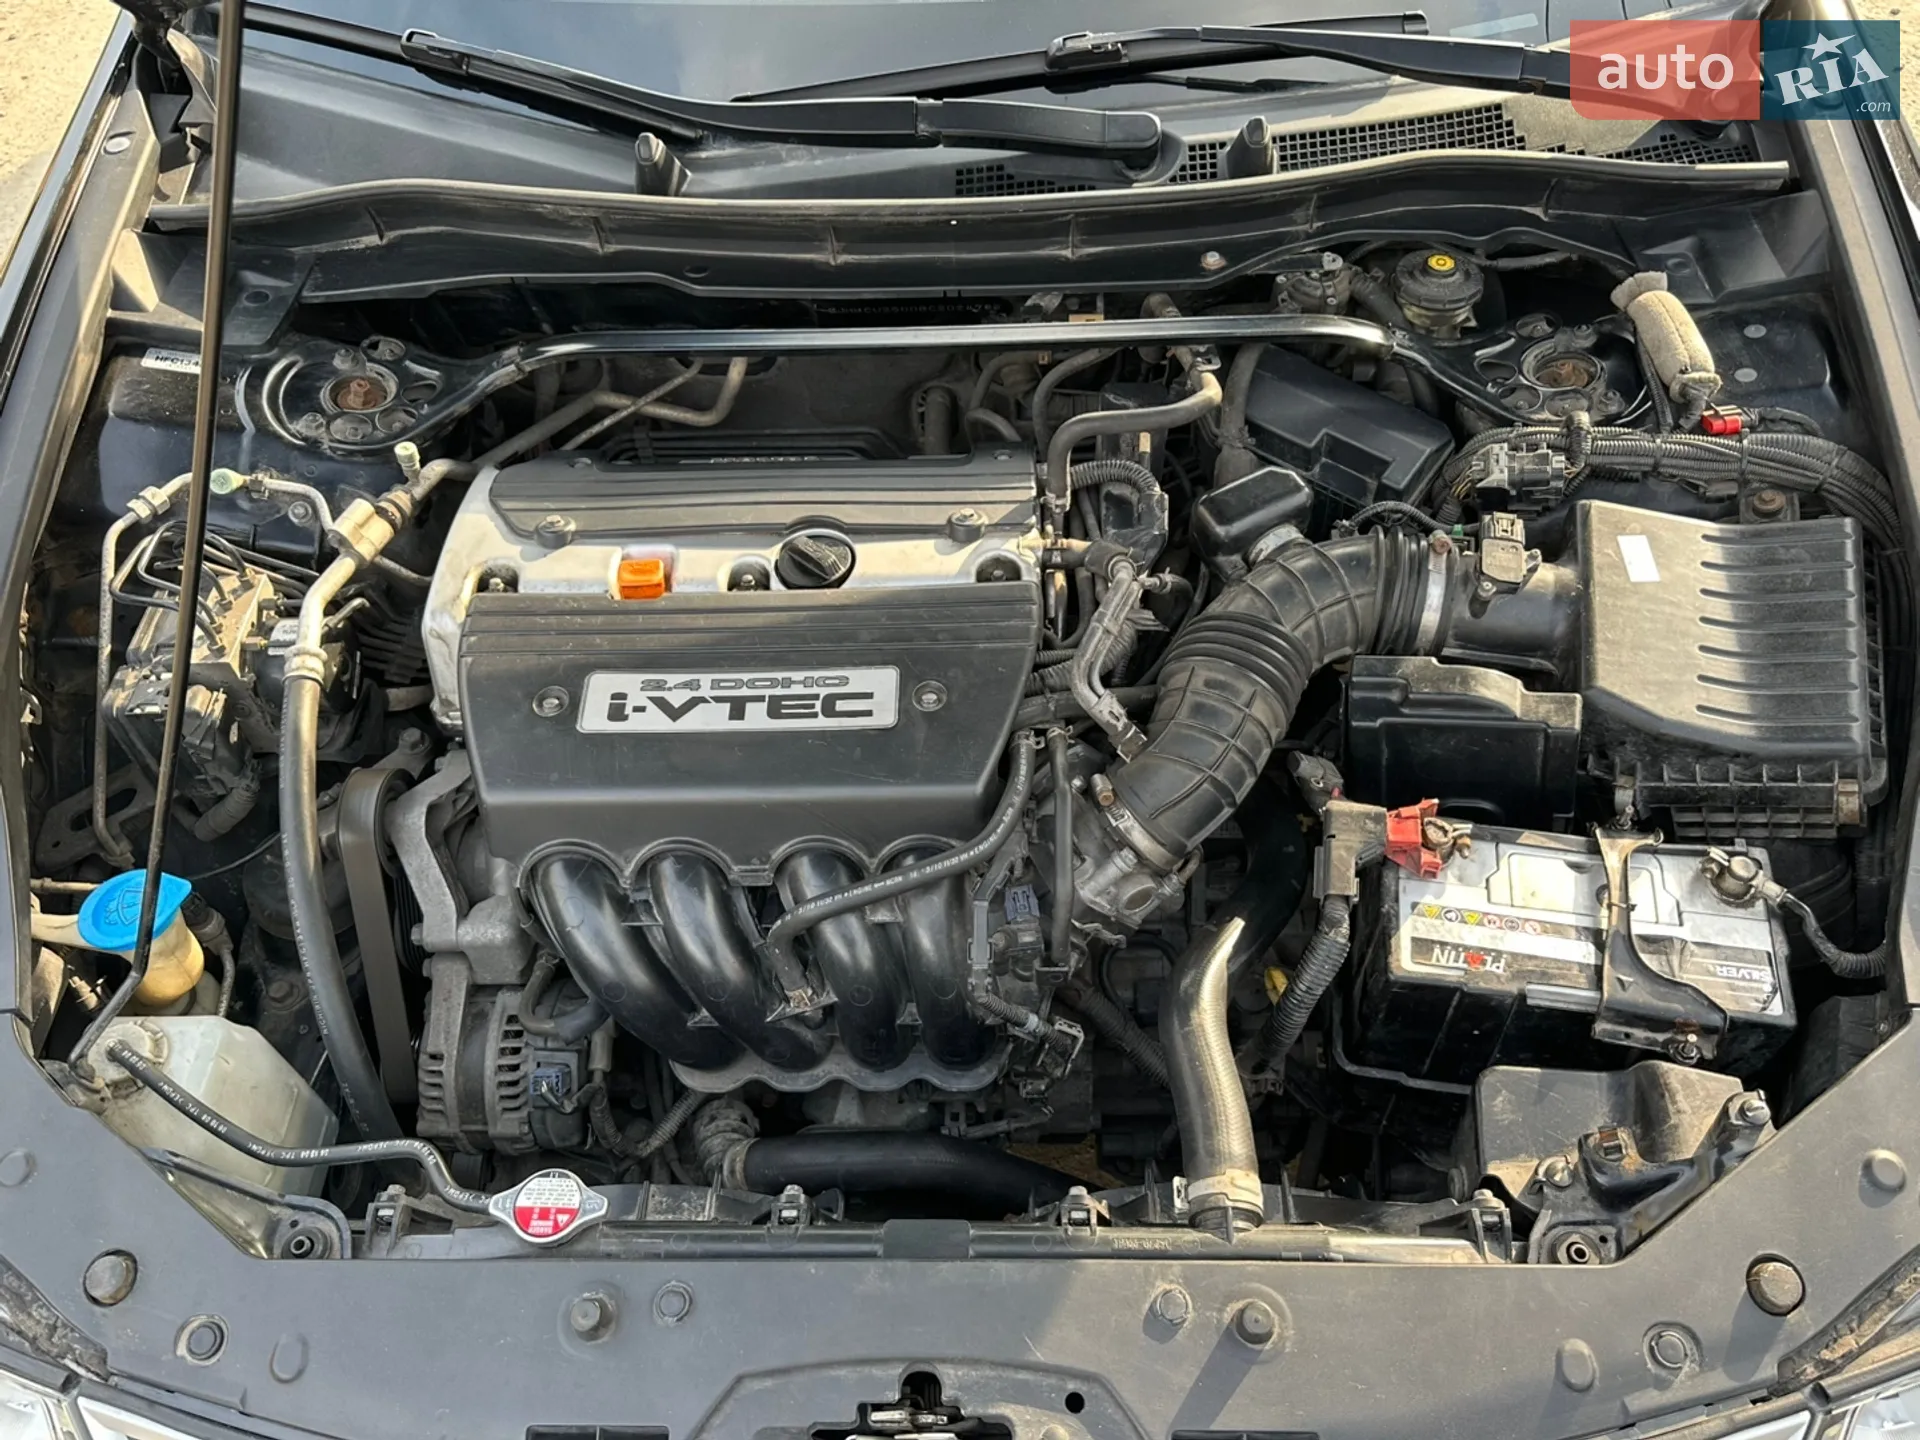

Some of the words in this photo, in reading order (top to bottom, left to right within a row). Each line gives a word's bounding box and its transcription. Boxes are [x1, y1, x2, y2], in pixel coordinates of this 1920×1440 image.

[640, 678, 702, 692] 2.4
[710, 675, 850, 691] DOHC
[608, 692, 874, 722] i-VTEC
[1431, 948, 1506, 973] PLATIN
[1713, 963, 1774, 981] SILVER
